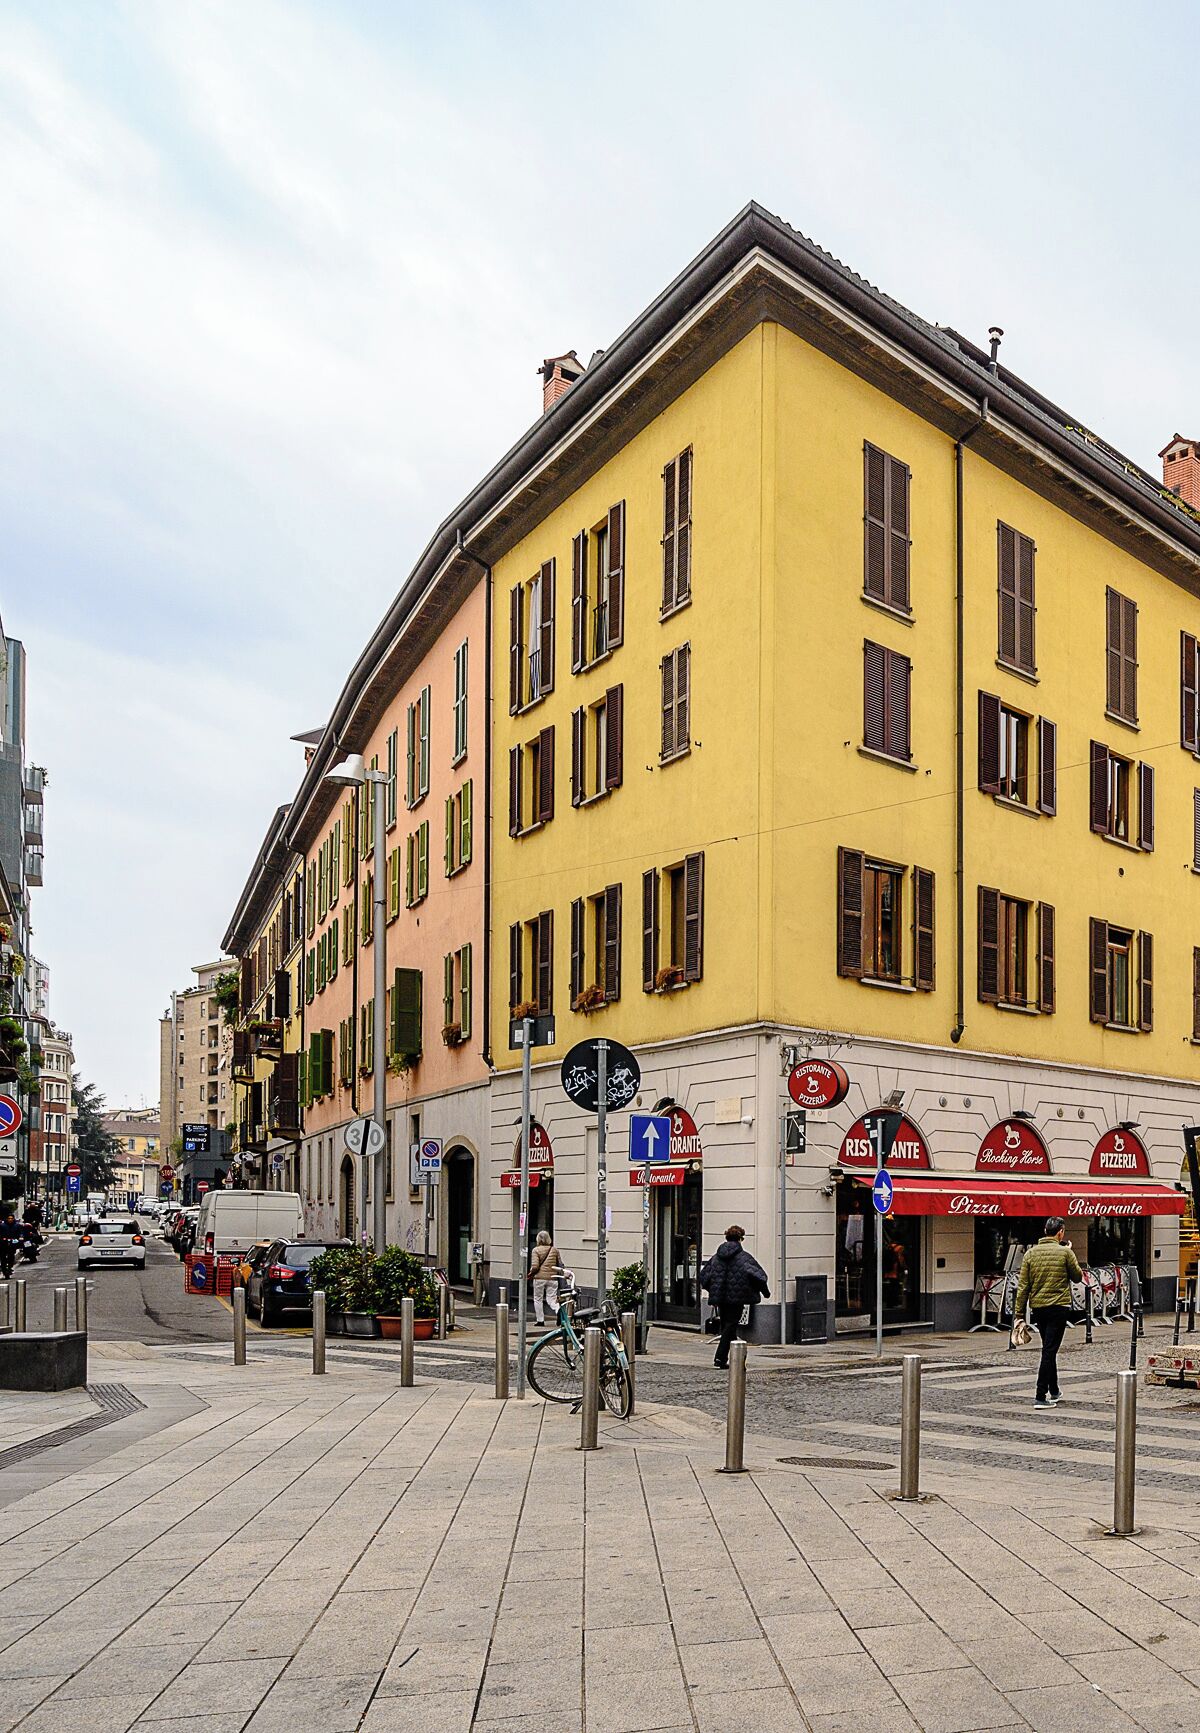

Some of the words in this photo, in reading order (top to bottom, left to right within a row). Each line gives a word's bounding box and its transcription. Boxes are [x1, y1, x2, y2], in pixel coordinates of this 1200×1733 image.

[795, 1064, 832, 1079] RISTORANTE
[798, 1093, 827, 1105] PIZZERIA
[350, 1128, 381, 1146] 30
[670, 1135, 702, 1154] ORANTE
[529, 1146, 550, 1162] IZZERIA
[845, 1138, 920, 1159] RISTANTE
[980, 1148, 1018, 1168] Rocking
[1019, 1149, 1044, 1165] Horse
[1099, 1152, 1137, 1169] PIZZERIA
[161, 1169, 173, 1177] STOP
[636, 1170, 676, 1184] Ritorante
[948, 1195, 1000, 1214] Pizza
[1067, 1198, 1143, 1216] Ristorante
